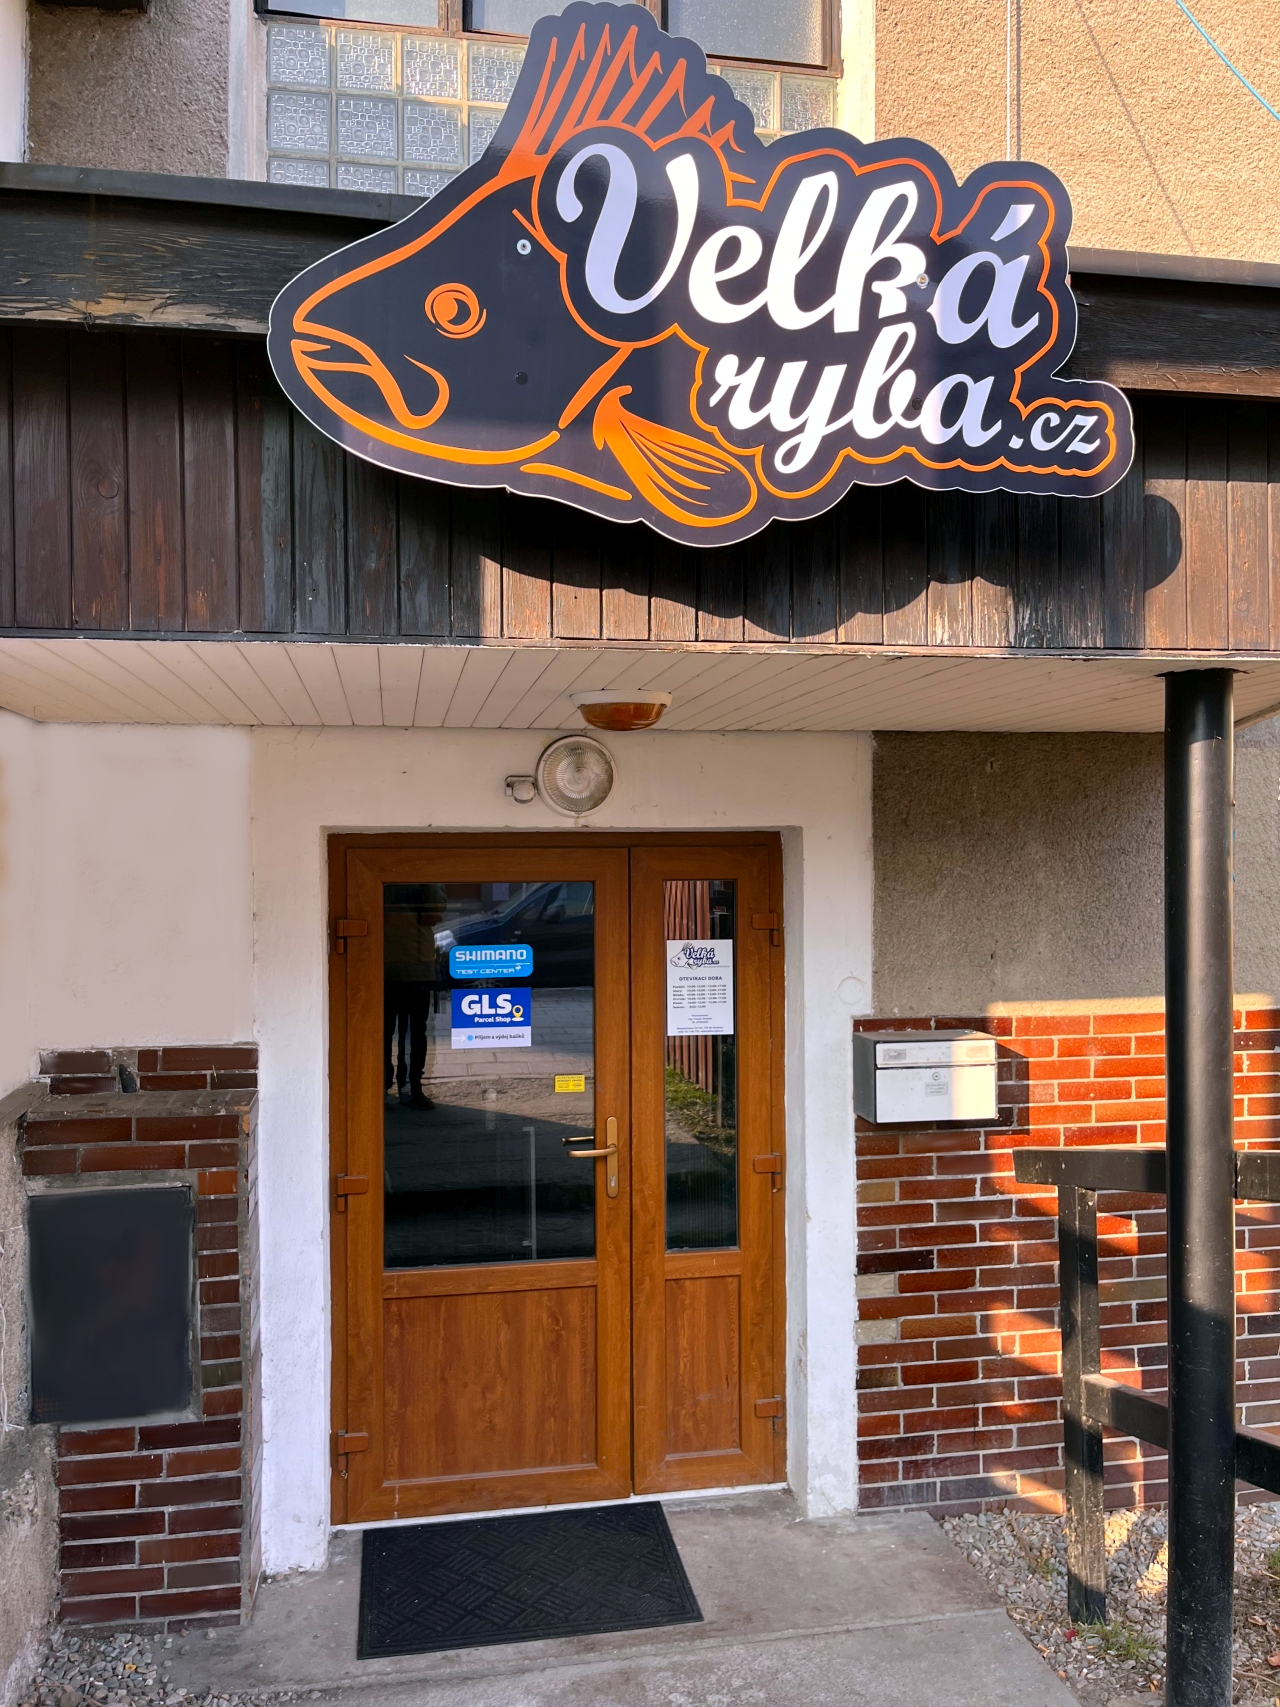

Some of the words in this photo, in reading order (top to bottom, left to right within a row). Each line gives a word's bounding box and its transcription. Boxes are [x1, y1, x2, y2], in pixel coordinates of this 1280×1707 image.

[556, 143, 1039, 348] Velká
[455, 949, 526, 961] SHIMANO
[684, 947, 715, 959] Velká
[461, 994, 512, 1015] GLS
